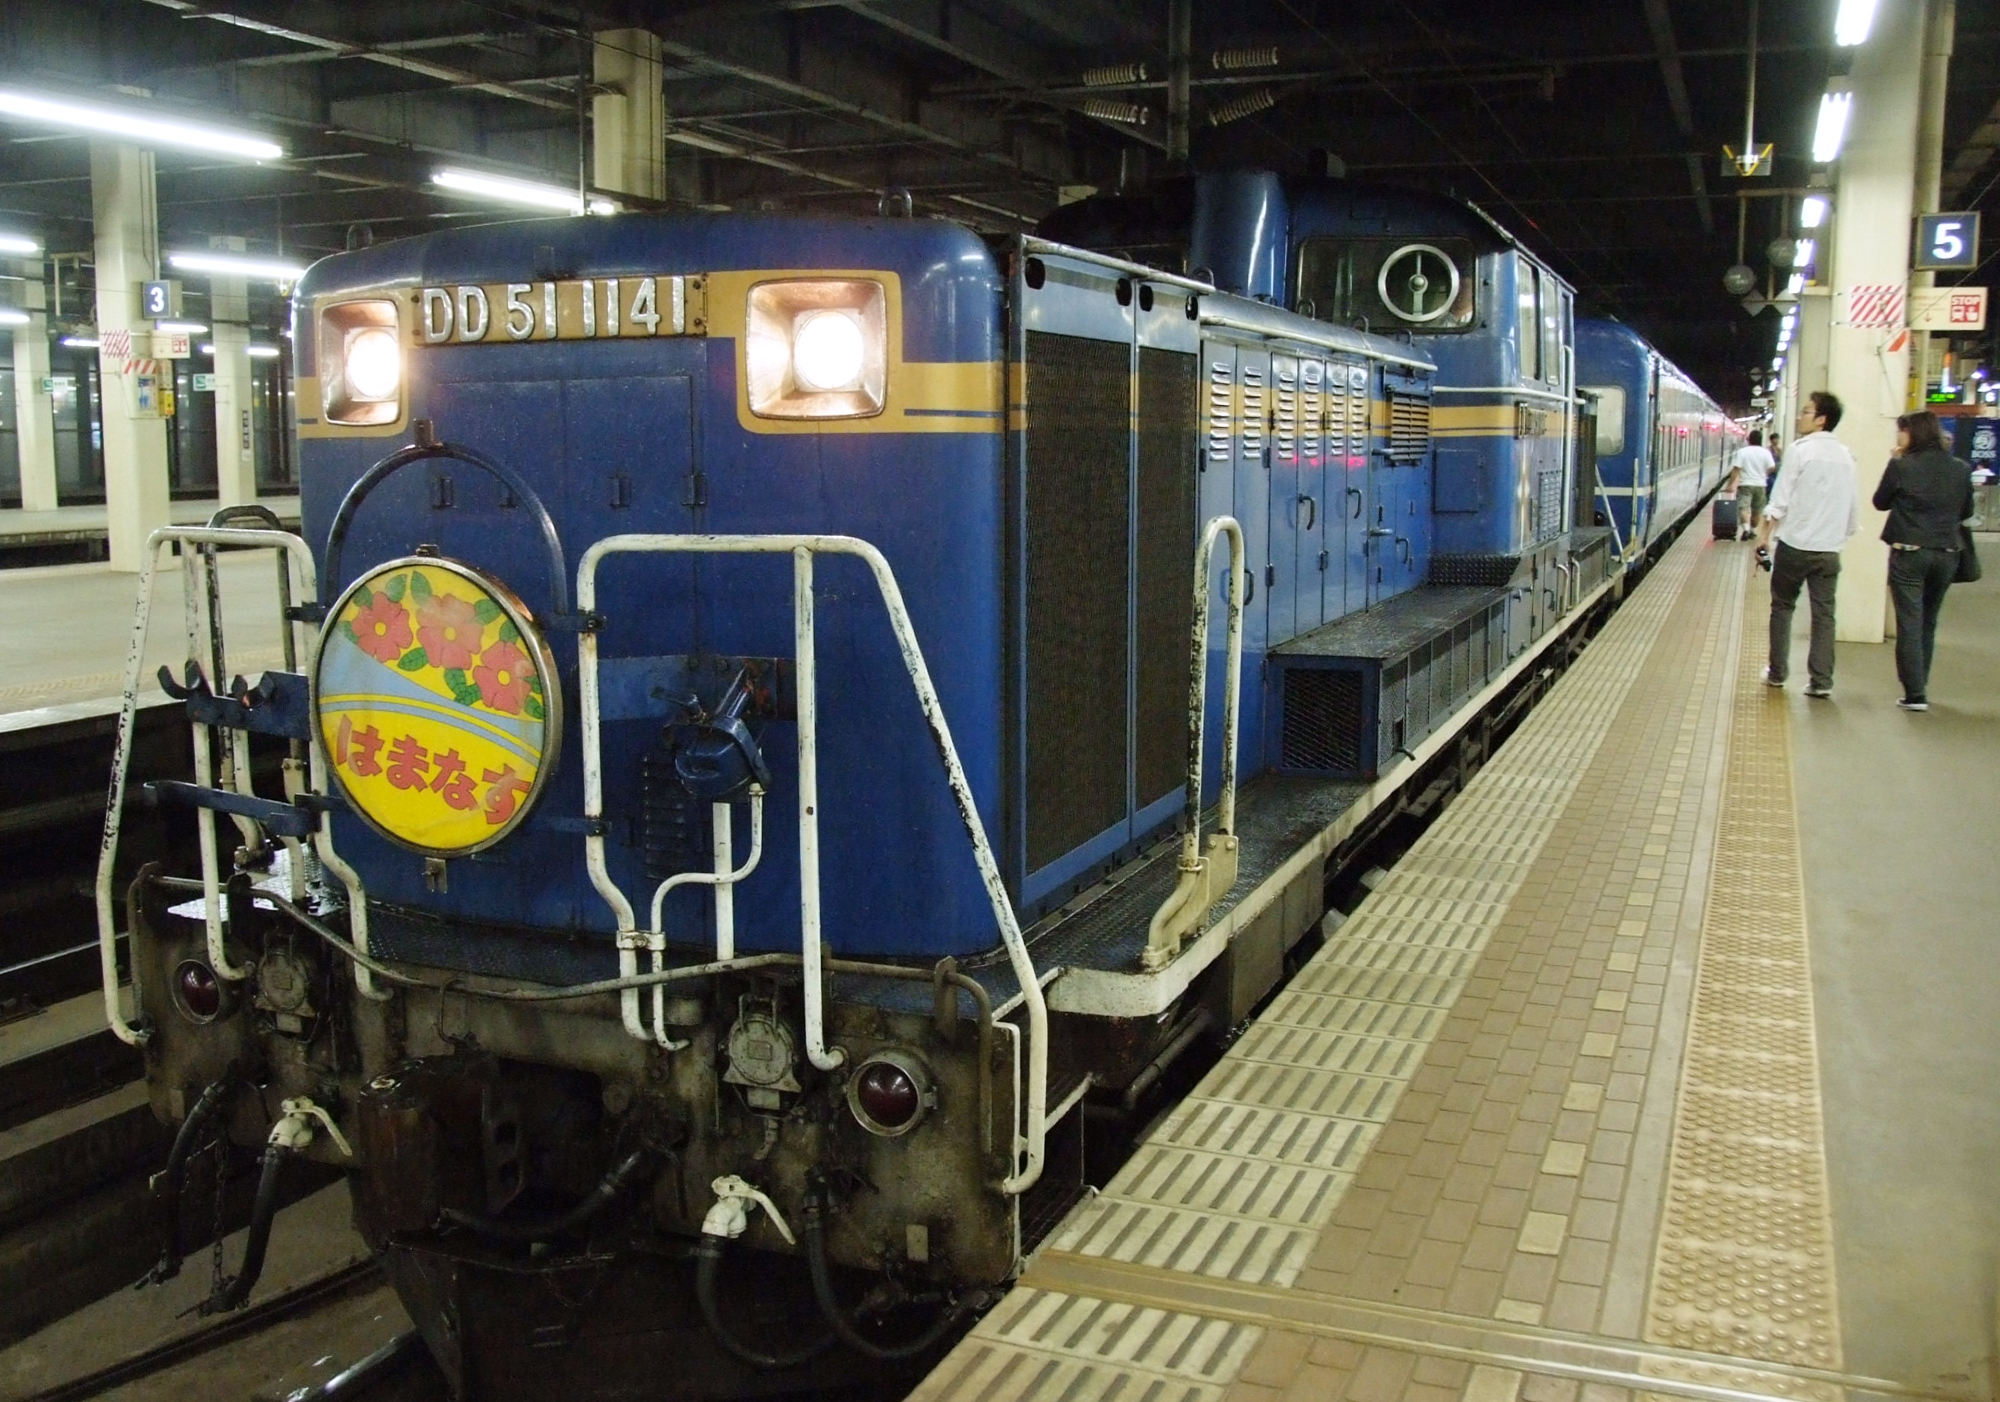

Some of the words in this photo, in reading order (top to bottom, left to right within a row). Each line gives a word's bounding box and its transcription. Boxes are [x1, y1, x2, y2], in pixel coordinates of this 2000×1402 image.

[1932, 223, 1963, 259] 5
[150, 286, 165, 313] 3
[423, 285, 490, 344] DD
[506, 282, 557, 340] 51
[582, 275, 686, 337] 1141
[1951, 296, 1980, 306] STOP
[1971, 450, 1997, 459] BOSS
[336, 713, 532, 825] はまなす
